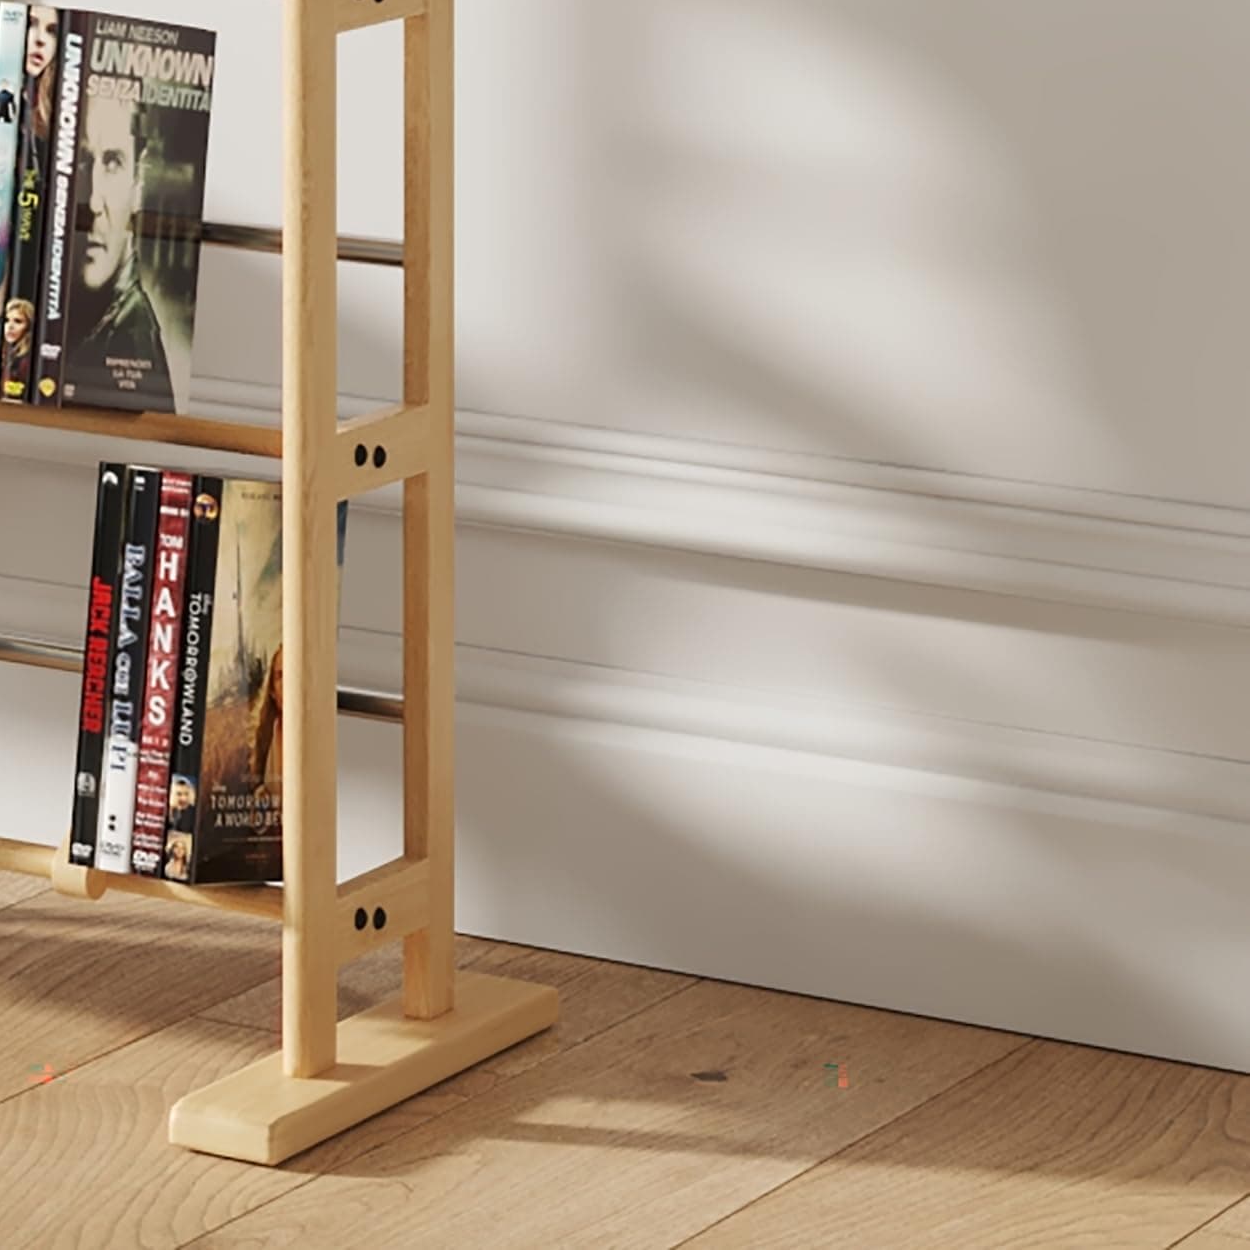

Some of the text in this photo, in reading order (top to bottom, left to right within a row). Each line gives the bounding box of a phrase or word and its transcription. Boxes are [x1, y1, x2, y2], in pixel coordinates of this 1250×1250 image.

[90, 37, 214, 87] UNKNOWN
[95, 19, 180, 46] LIAM NEESON
[56, 33, 83, 175] UNKNOWN
[86, 73, 141, 103] SENZA
[18, 191, 39, 209] 5
[53, 176, 69, 237] SENZA
[160, 533, 184, 549] TOM
[117, 542, 145, 649] BALLA
[81, 575, 113, 734] JACK REACHER
[147, 551, 179, 726] HANKS
[179, 592, 201, 746] TOMORROWLAND
[110, 698, 134, 771] LUPI
